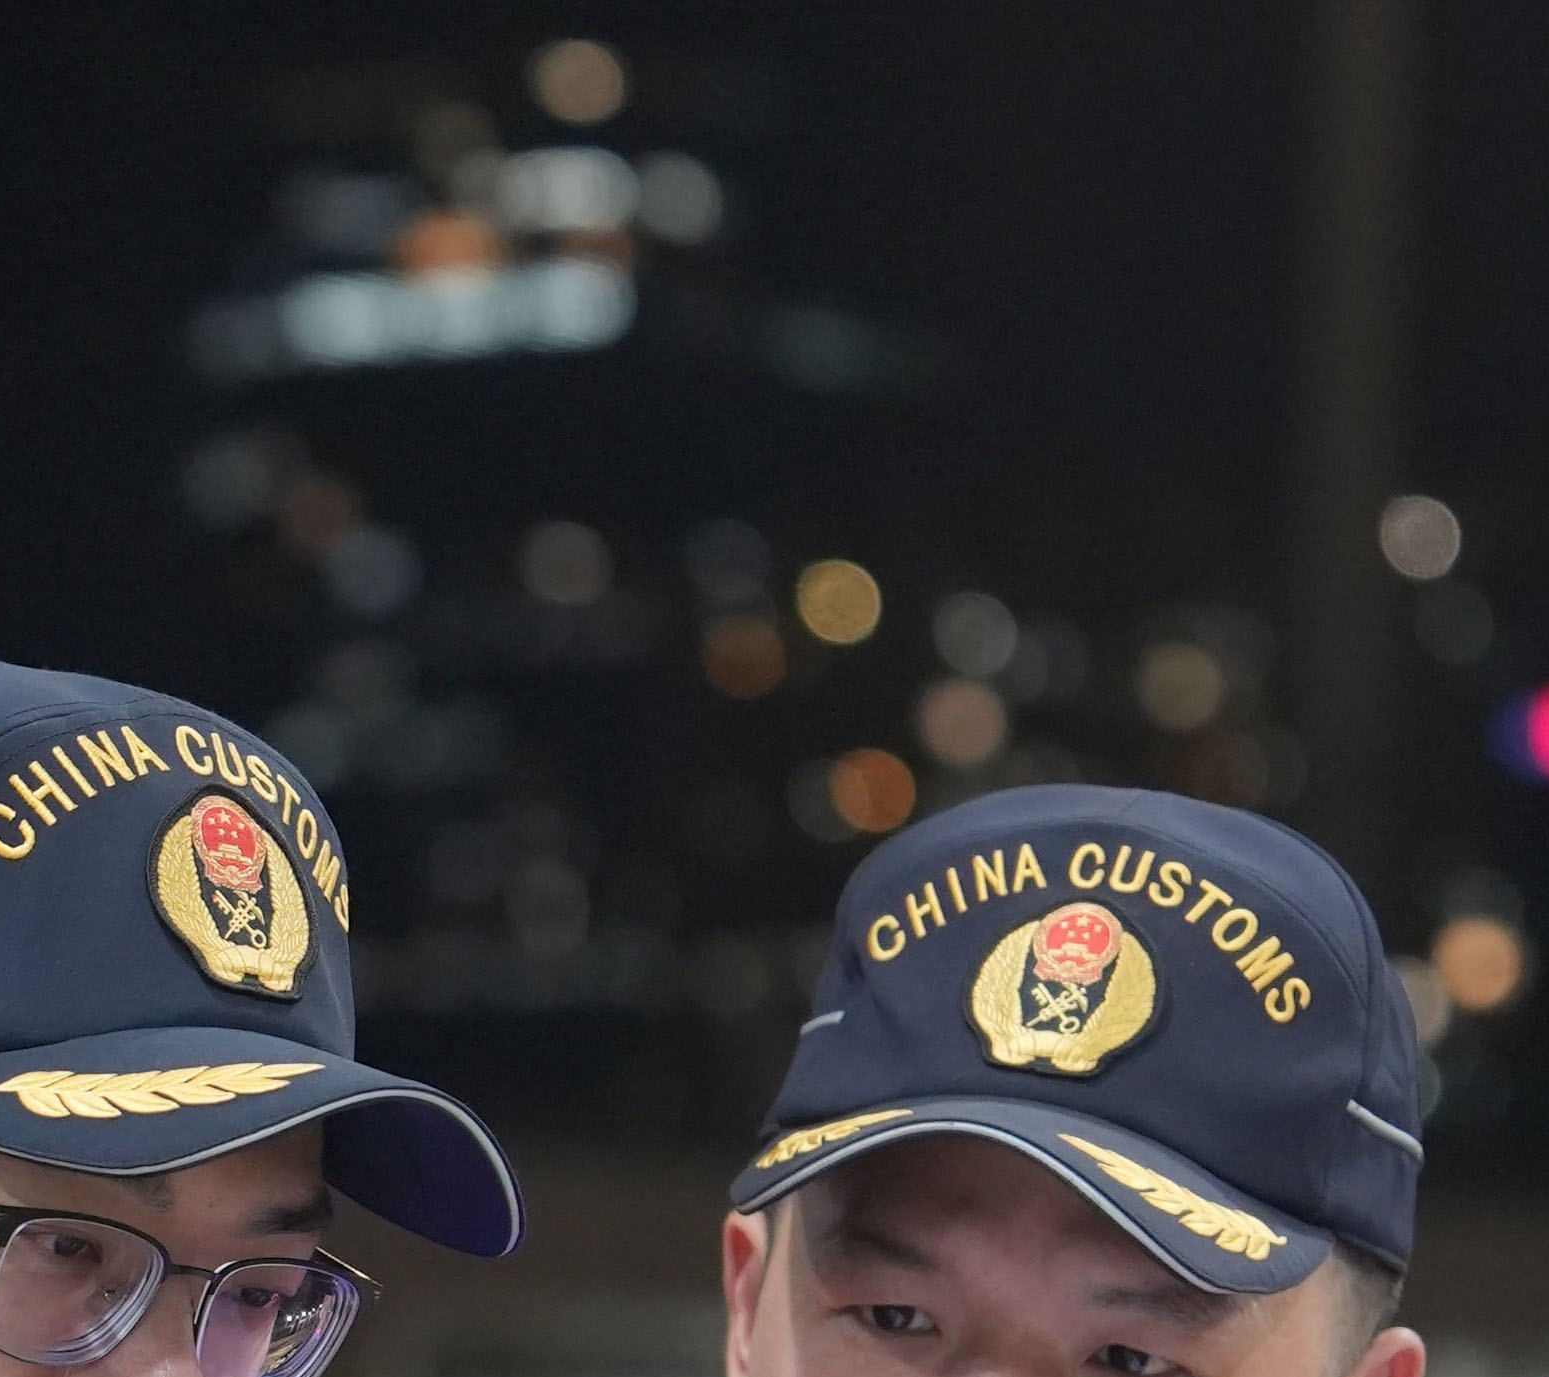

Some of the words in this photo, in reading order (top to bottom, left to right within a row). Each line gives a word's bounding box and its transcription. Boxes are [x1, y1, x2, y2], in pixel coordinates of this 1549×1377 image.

[176, 725, 349, 932] CUSTOMS
[867, 843, 1047, 962] CHINA
[1069, 843, 1311, 1024] CUSTOMS
